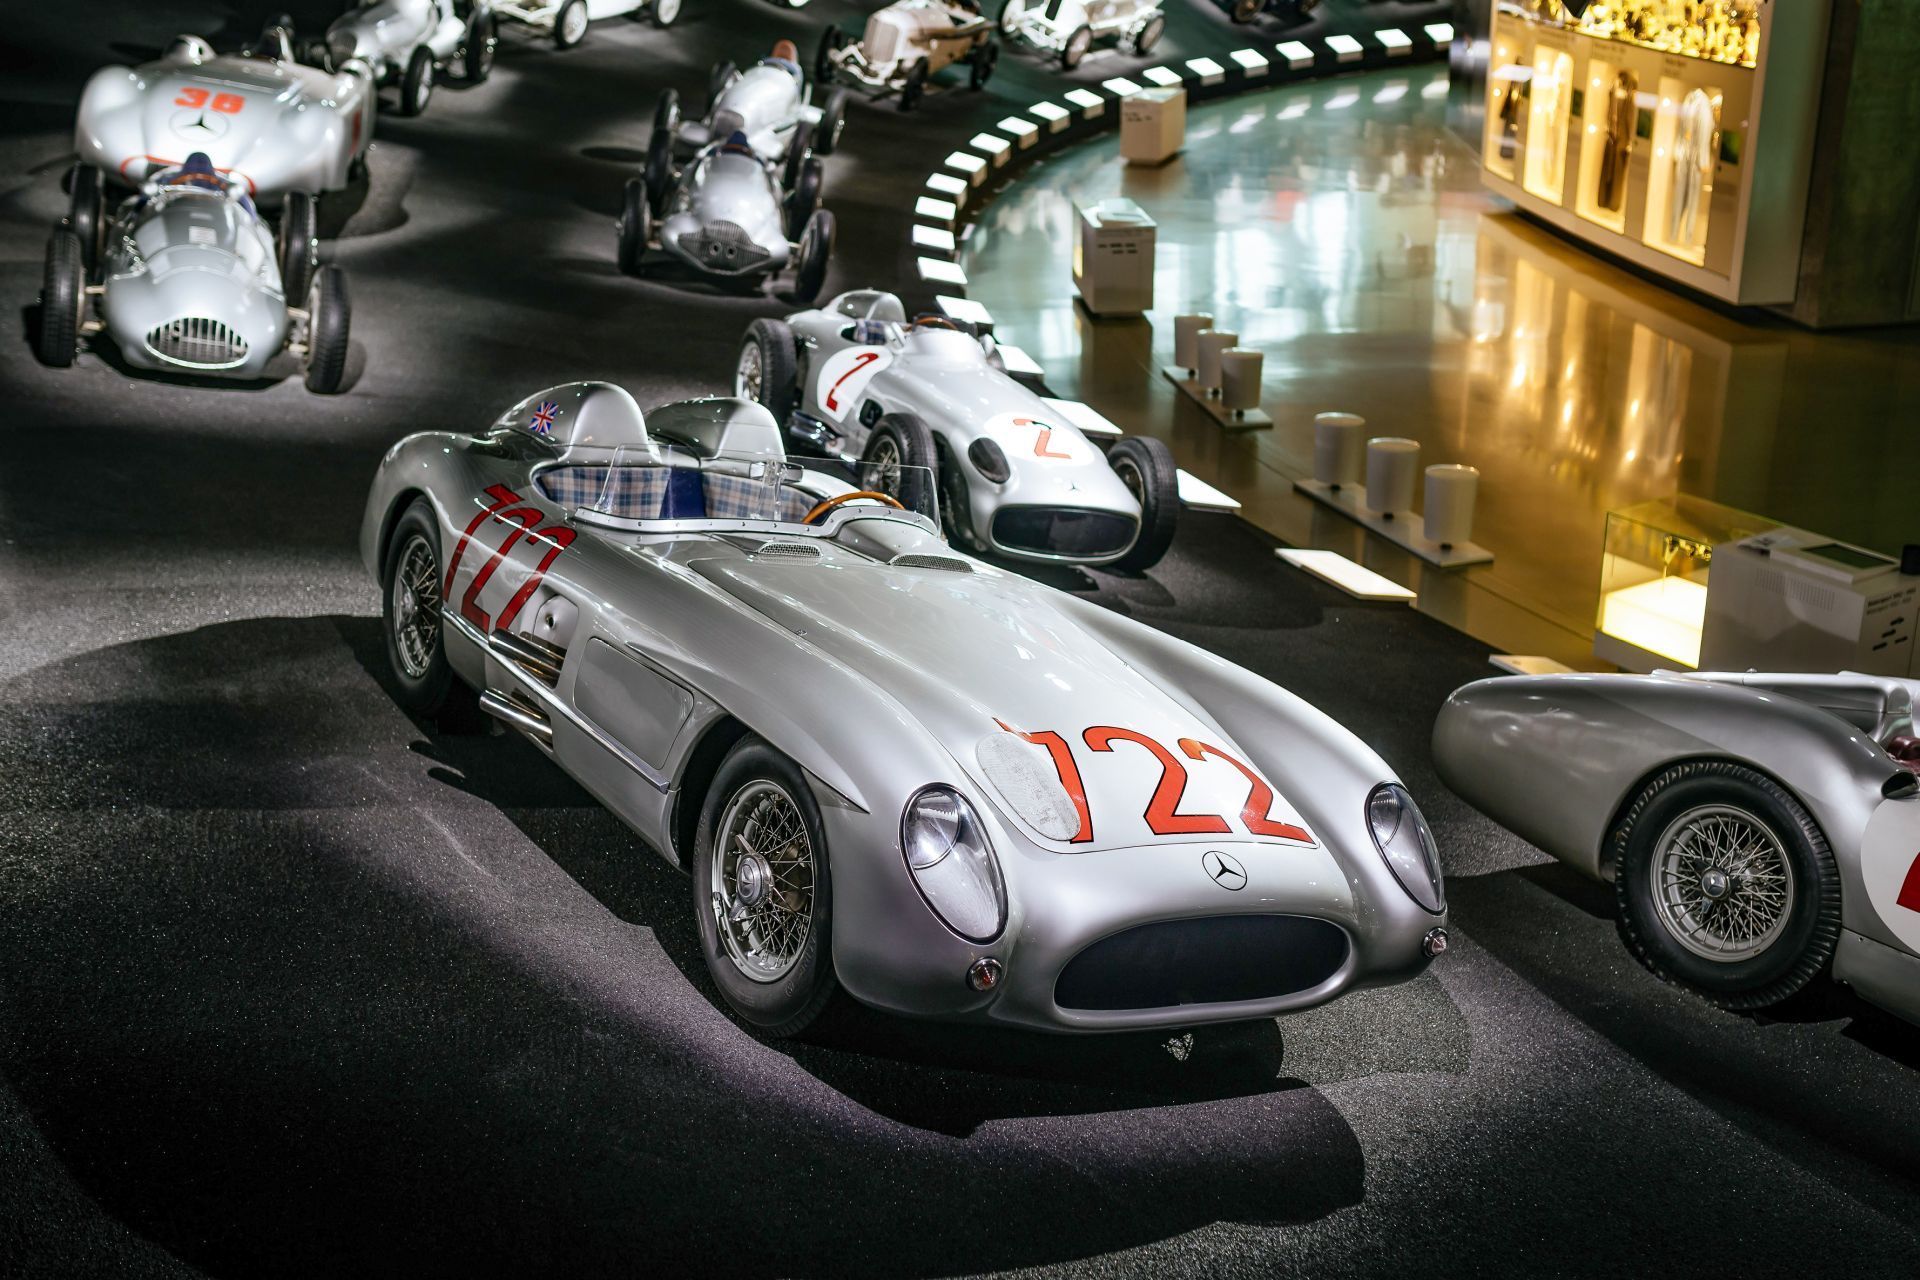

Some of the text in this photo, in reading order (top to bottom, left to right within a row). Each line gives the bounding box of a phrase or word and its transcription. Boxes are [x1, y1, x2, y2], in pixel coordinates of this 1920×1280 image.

[826, 352, 880, 413] 2
[1012, 418, 1073, 460] 2
[442, 482, 578, 636] 722
[992, 716, 1317, 845] 722
